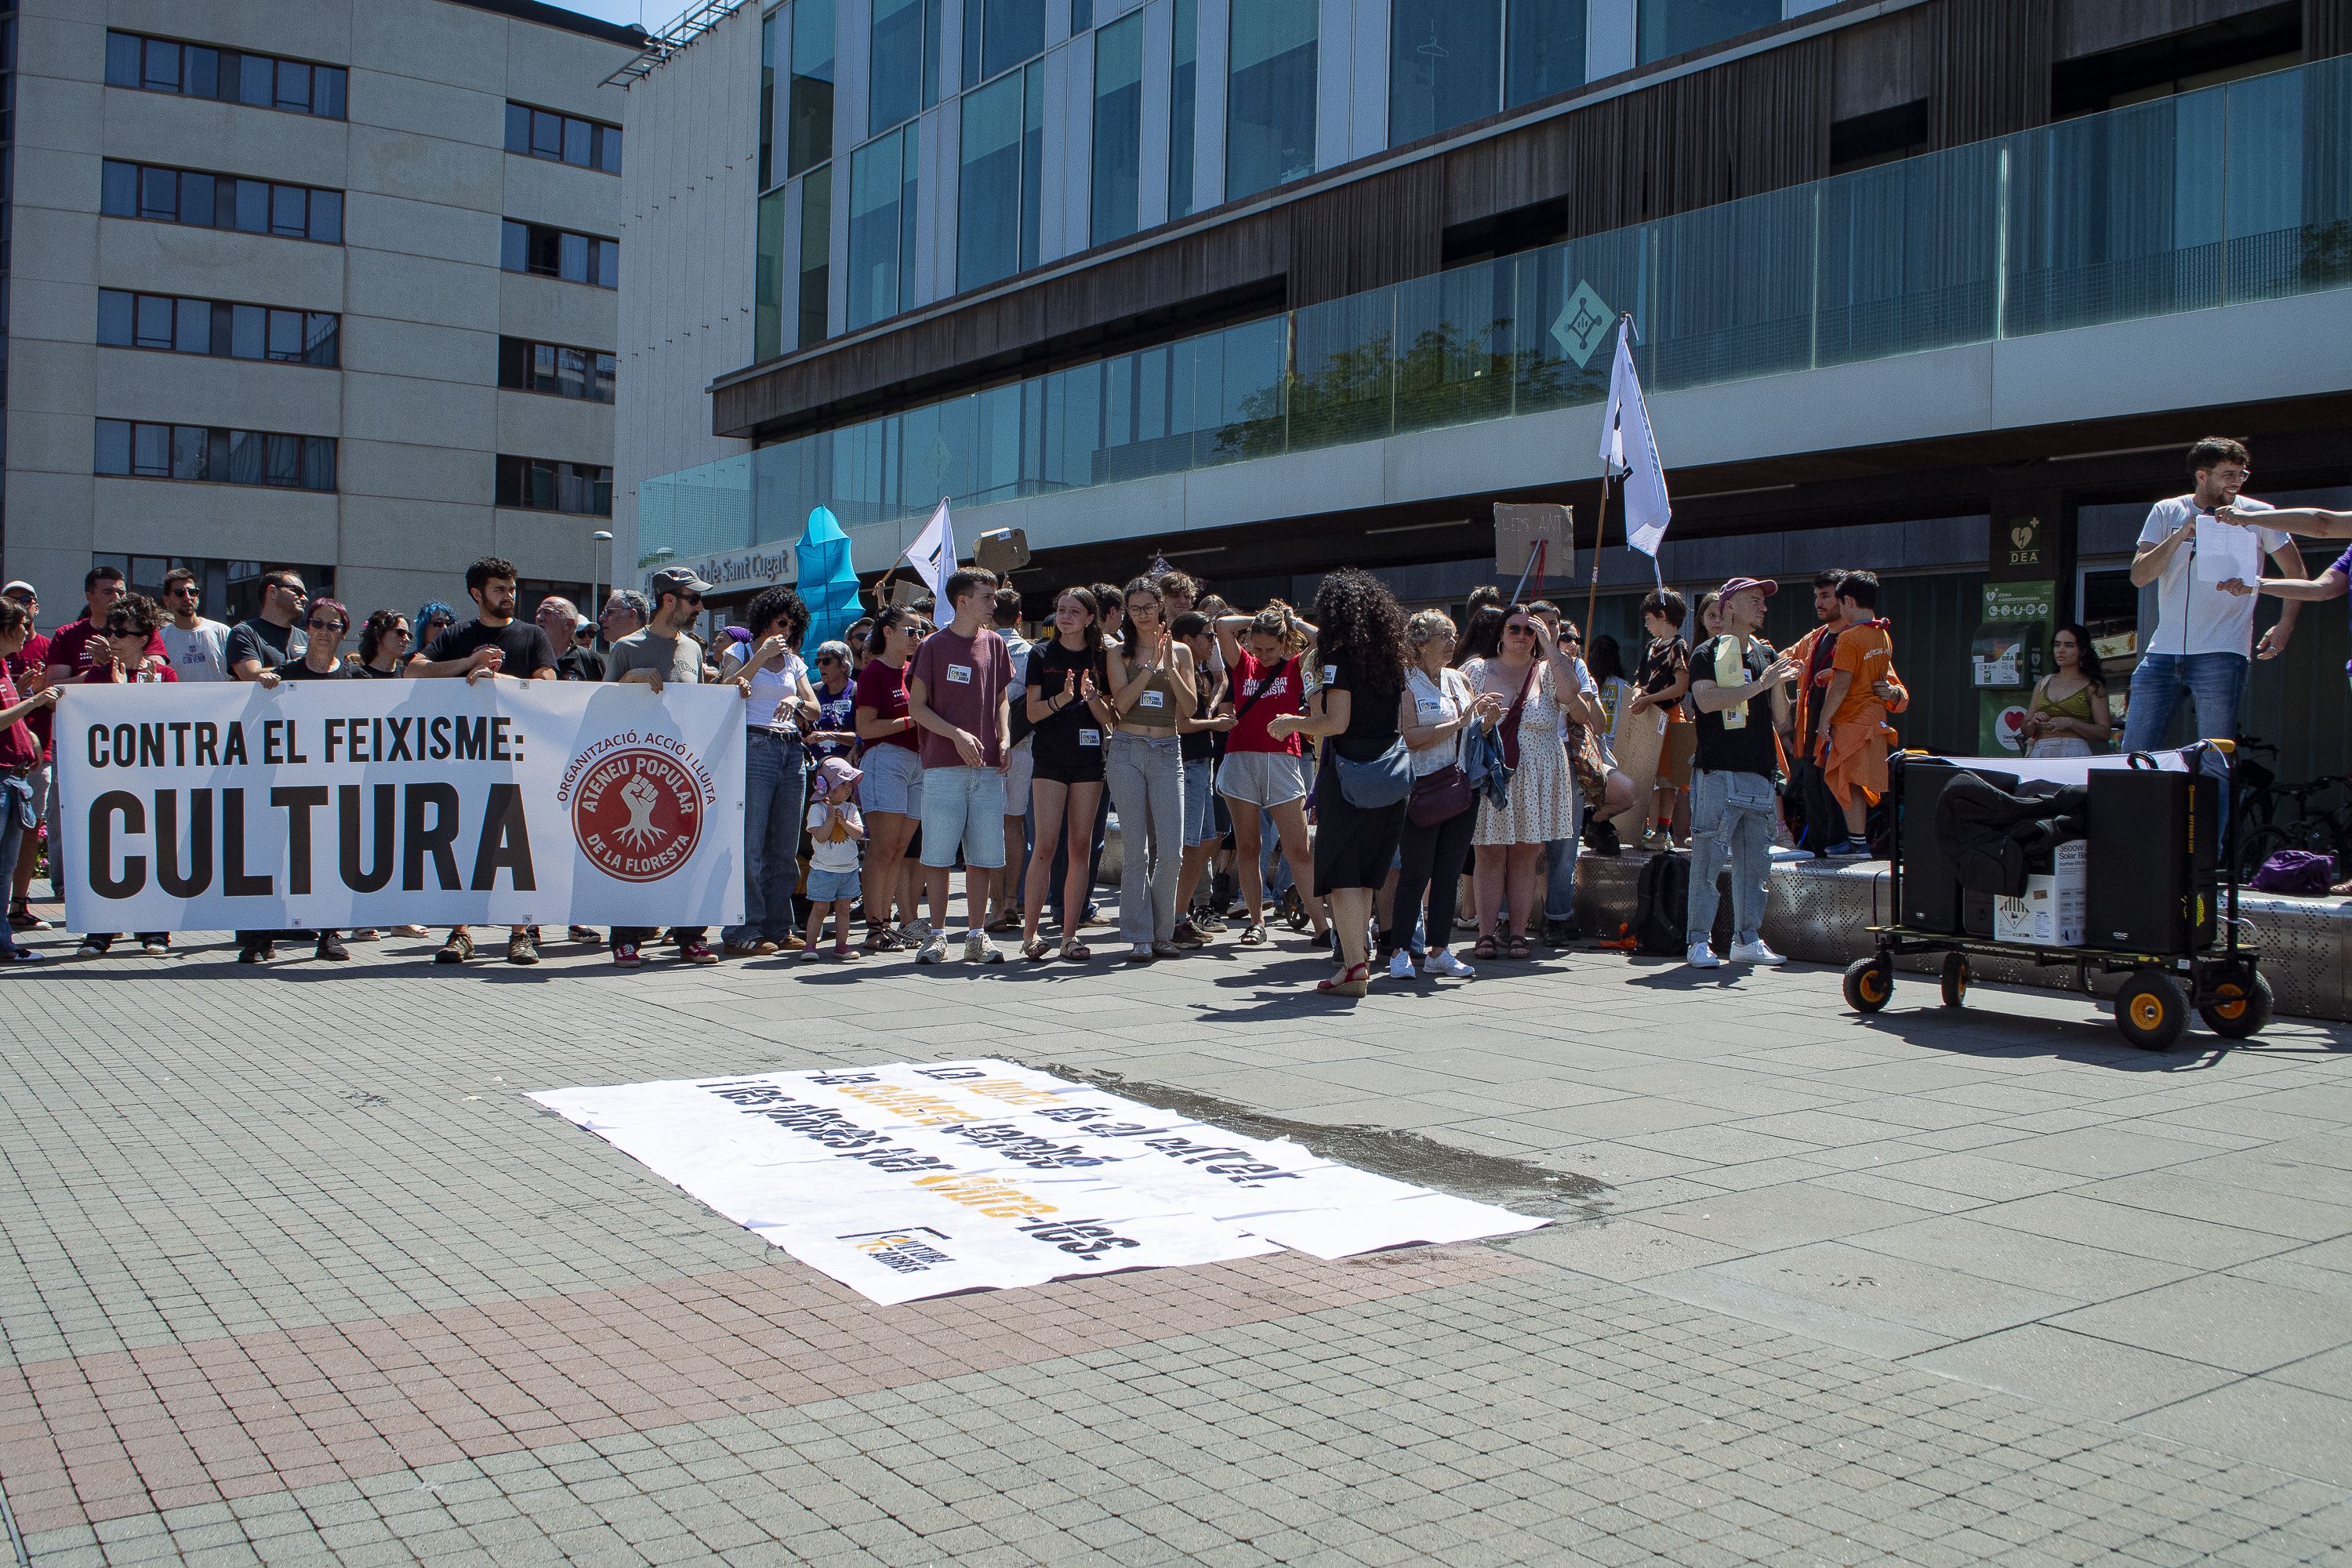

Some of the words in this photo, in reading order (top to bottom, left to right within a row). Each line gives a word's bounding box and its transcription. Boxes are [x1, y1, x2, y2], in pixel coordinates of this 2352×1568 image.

[706, 560, 720, 583] de
[723, 557, 750, 582] Sant
[752, 550, 789, 582] Cugat
[2011, 553, 2038, 563] DEA
[88, 720, 248, 768] CONTRA
[263, 720, 307, 764] EL
[325, 716, 524, 763] FEIXISME:
[557, 729, 641, 802] ORGANITZACIÓ,
[644, 732, 688, 756] ACCIÓ
[684, 753, 694, 761] I
[691, 758, 717, 805] LLUITA
[582, 758, 630, 813] ATENEU
[636, 757, 694, 815] POPULAR
[89, 782, 536, 899] CULTURA
[586, 833, 607, 855] DE
[603, 850, 622, 868] LA
[625, 834, 690, 872] FLORESTA
[710, 1085, 796, 1105] les
[806, 1073, 881, 1085] la
[838, 1085, 982, 1125] cultura
[913, 1067, 987, 1080] La
[1078, 1122, 1172, 1138] al
[741, 1104, 893, 1149] places
[835, 1148, 957, 1173] per
[879, 1235, 956, 1263] CULTURA
